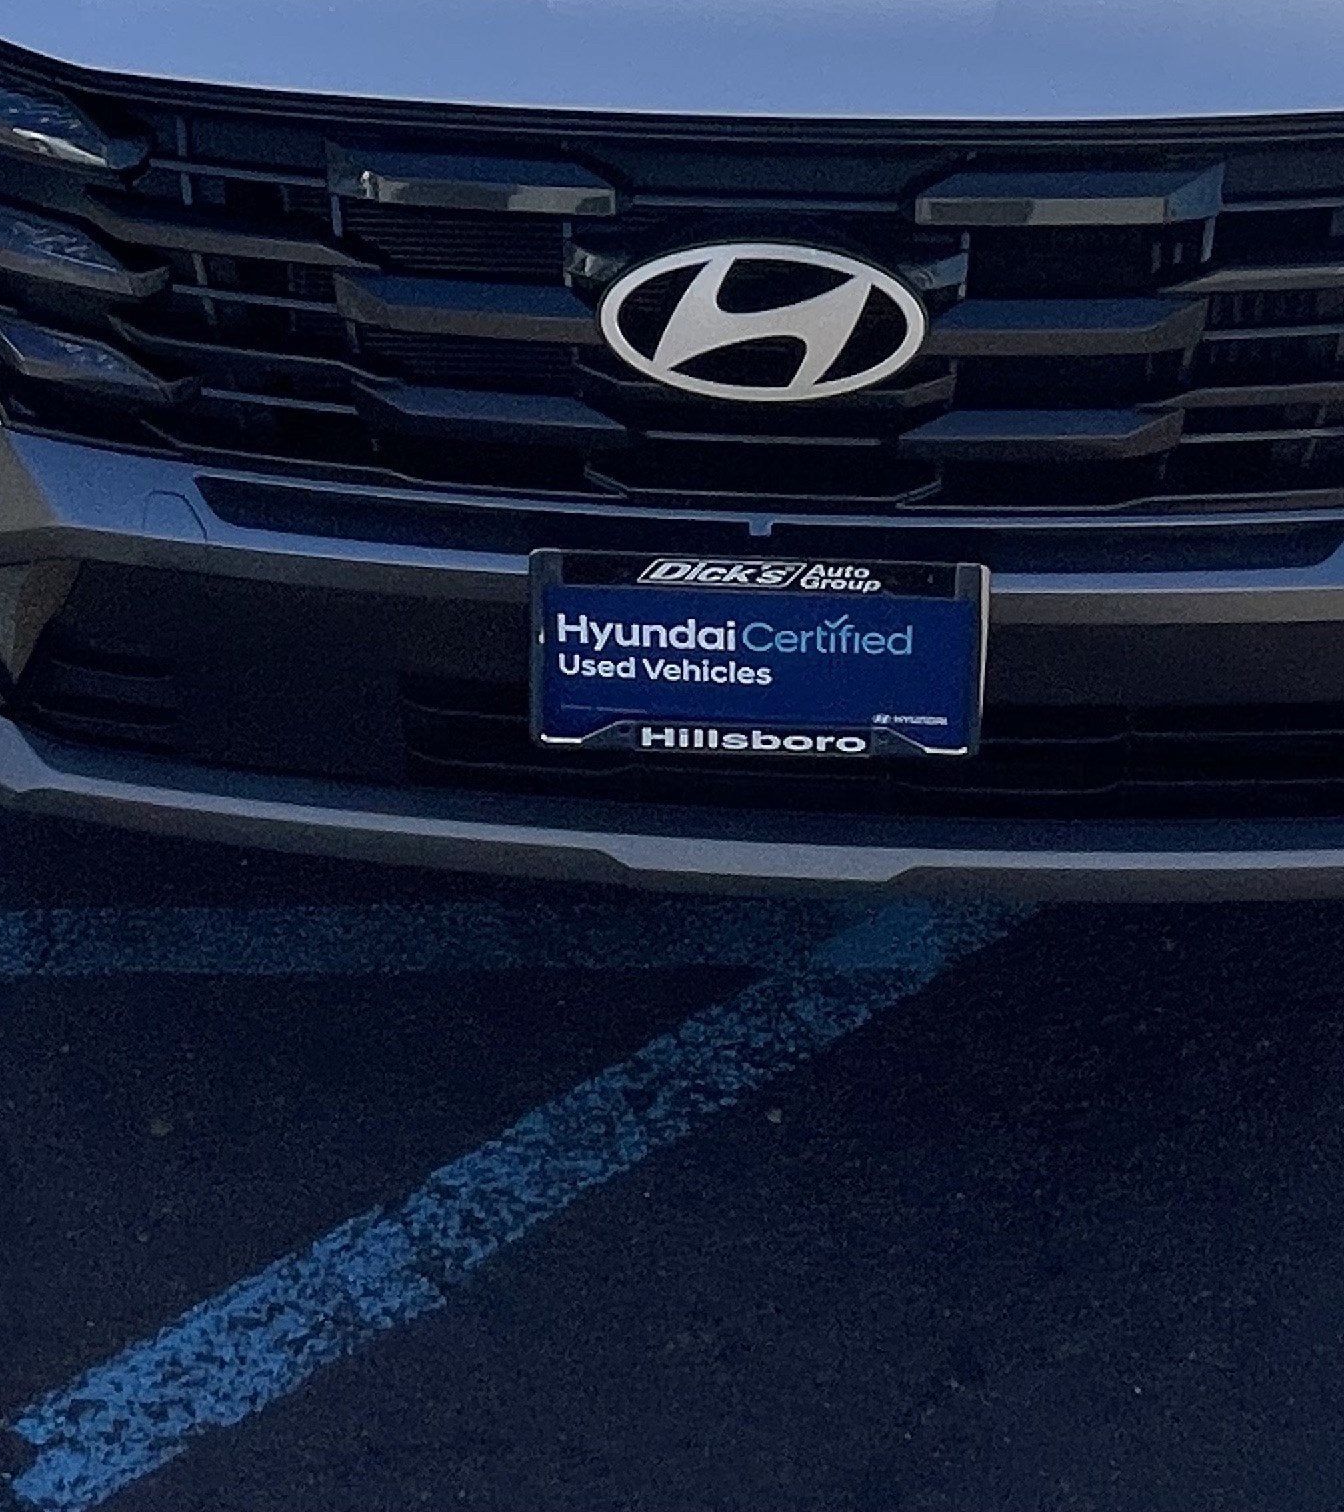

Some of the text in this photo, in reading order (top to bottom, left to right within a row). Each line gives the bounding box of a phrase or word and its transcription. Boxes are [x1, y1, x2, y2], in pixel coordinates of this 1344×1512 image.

[649, 562, 796, 585] Dick's
[805, 563, 870, 579] Auto
[800, 576, 882, 593] Group
[556, 612, 914, 656] Hyundai Certified
[557, 652, 774, 686] Used Vehicles
[641, 726, 867, 753] Hillsboro
